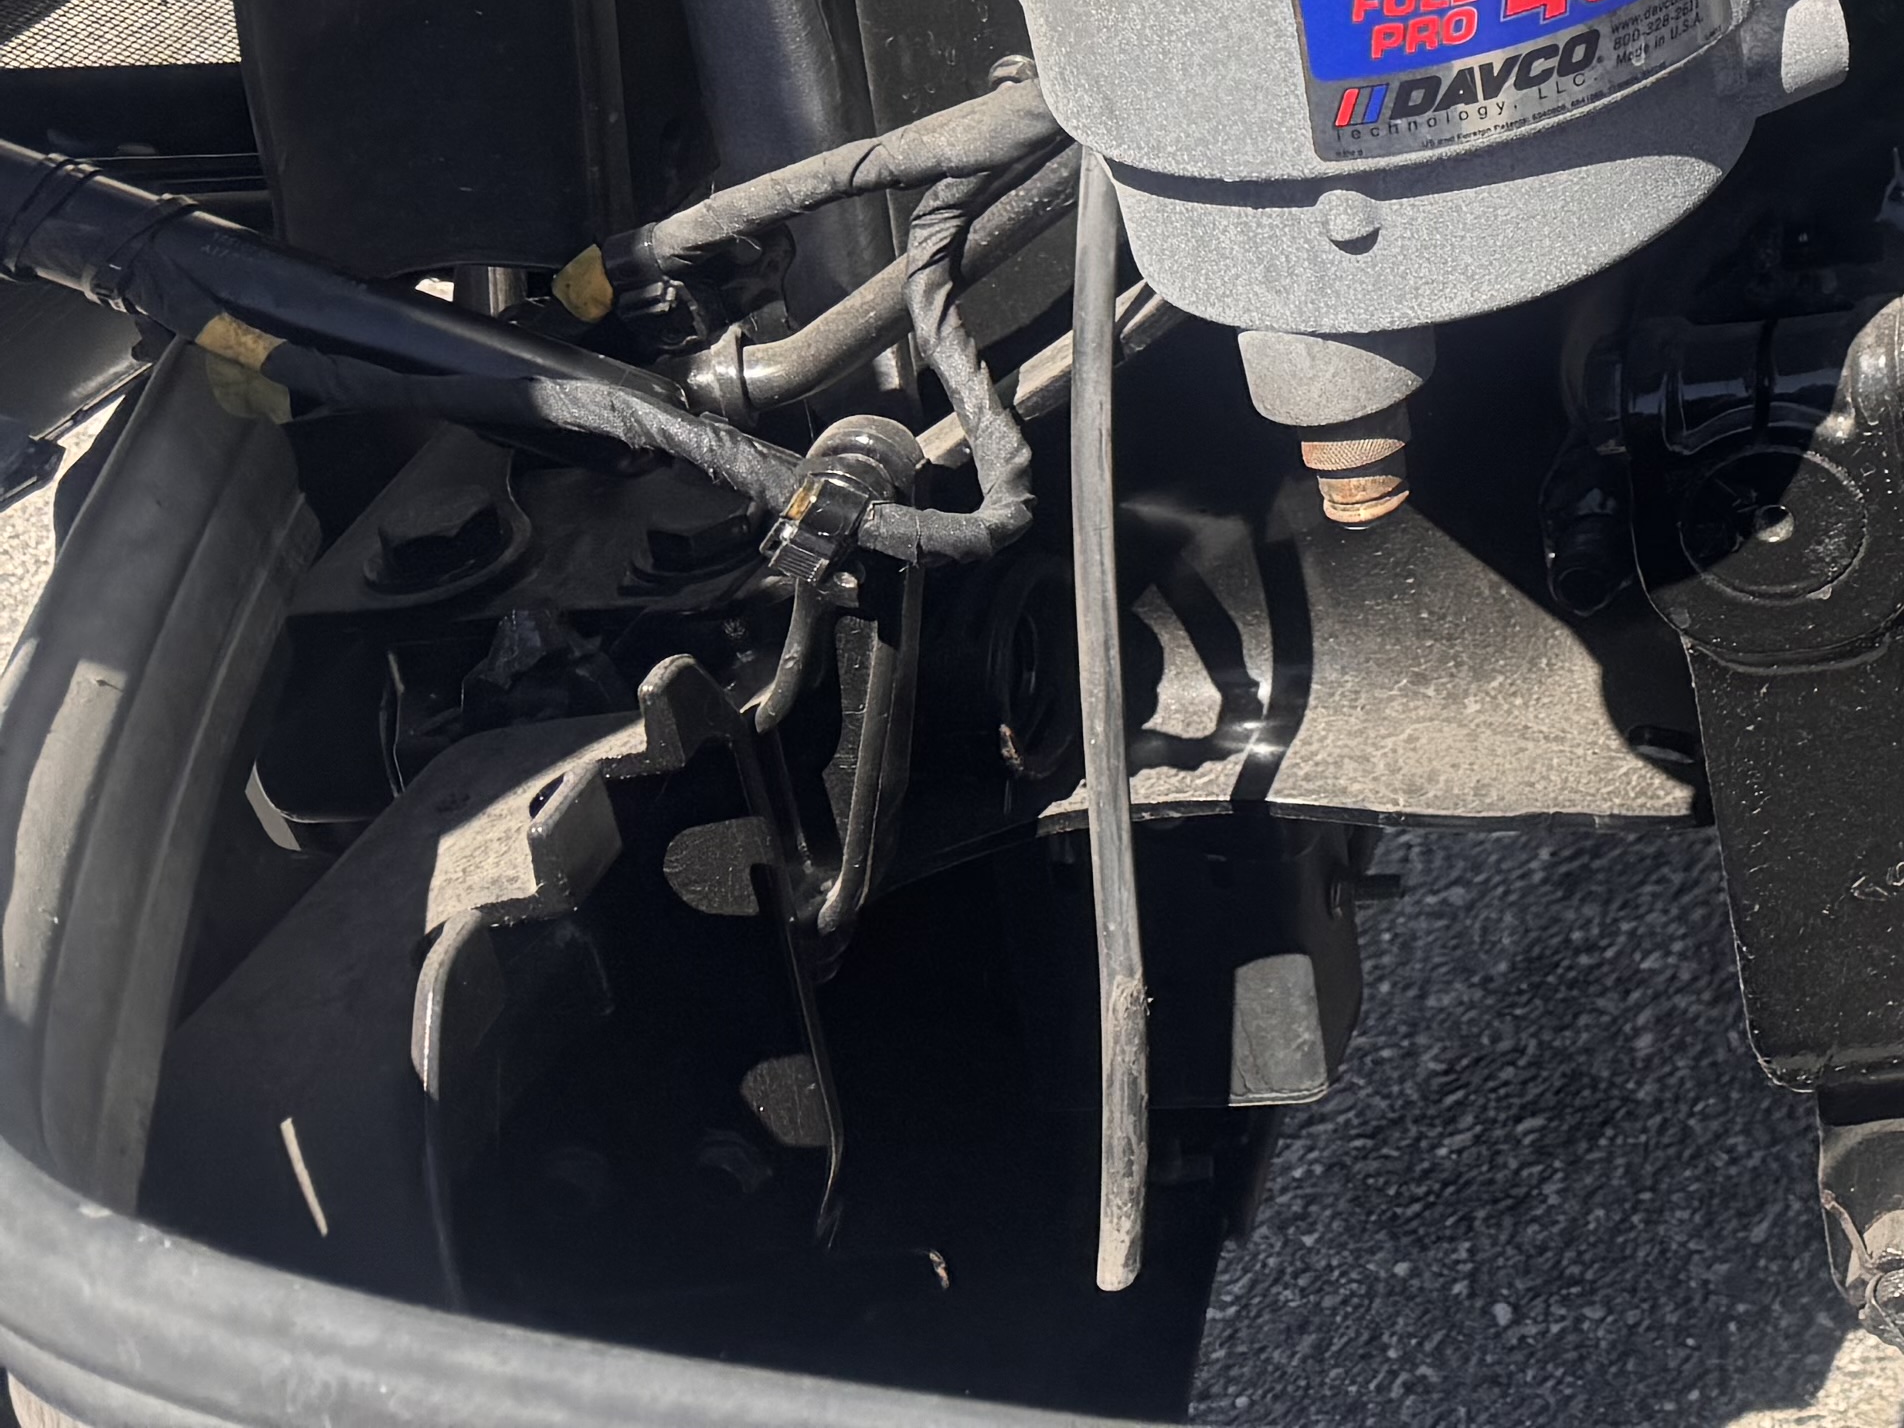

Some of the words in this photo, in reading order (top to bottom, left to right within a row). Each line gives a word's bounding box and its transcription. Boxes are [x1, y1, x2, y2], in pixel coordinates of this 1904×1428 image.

[1370, 6, 1478, 60] PRO
[1616, 43, 1650, 67] Made
[1655, 33, 1666, 49] in
[1670, 16, 1705, 43] U.S.A.
[1389, 29, 1600, 119] DAVCO
[1336, 101, 1518, 142] Technology,
